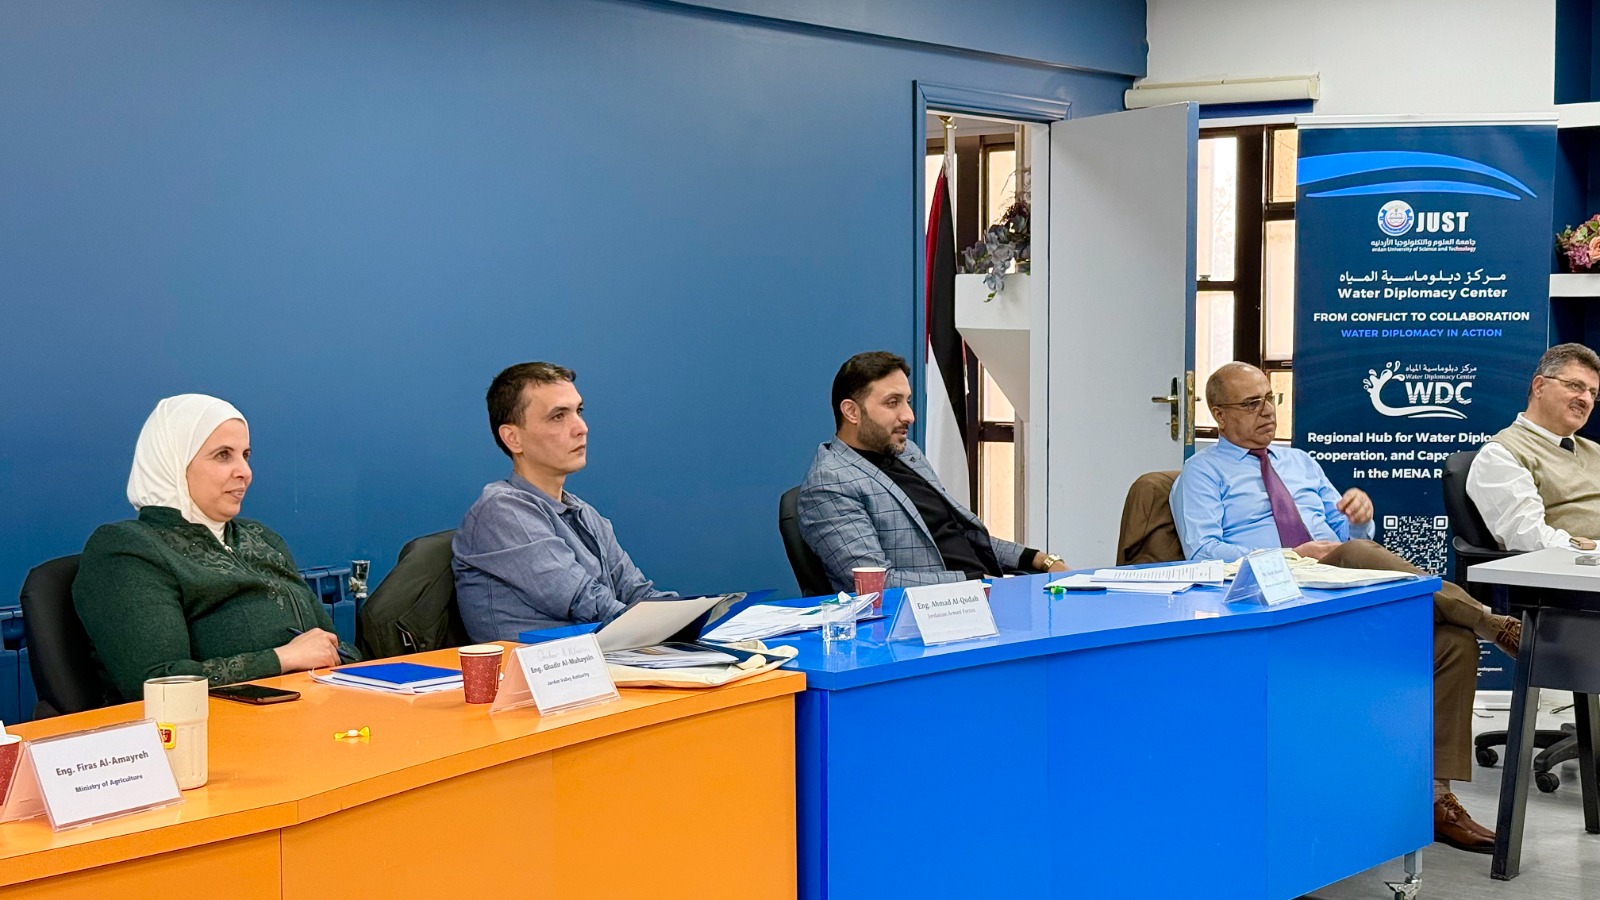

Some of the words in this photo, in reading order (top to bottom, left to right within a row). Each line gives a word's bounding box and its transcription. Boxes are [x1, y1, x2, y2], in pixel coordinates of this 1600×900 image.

[1416, 212, 1469, 232] JUST
[1338, 288, 1380, 298] Water
[1384, 287, 1457, 300] Diplomacy
[1460, 287, 1507, 298] Center
[1313, 312, 1348, 322] FROM
[1351, 312, 1408, 322] CONFLICT
[1411, 312, 1427, 321] TO
[1429, 312, 1530, 321] COLLABORATION
[1341, 329, 1378, 338] WATER
[1382, 329, 1444, 338] DIPLOMACY
[1447, 329, 1458, 337] IN
[1461, 329, 1502, 337] ACTION
[1460, 363, 1477, 373] مركز
[1405, 382, 1472, 405] WDC
[1308, 432, 1363, 445] Regional
[1366, 432, 1392, 443] Hub
[1395, 432, 1413, 443] for
[1415, 432, 1456, 443] Water
[1458, 432, 1492, 445] Diplo
[1308, 450, 1387, 462] Cooperation,
[1390, 450, 1414, 461] and
[1353, 468, 1364, 479] in
[1366, 468, 1389, 479] the
[1392, 468, 1431, 479] MENA
[1434, 468, 1443, 479] R
[917, 602, 930, 610] Eng.
[931, 599, 952, 608] Ahmad
[960, 595, 979, 605] Qudah
[530, 666, 543, 674] Eng.
[543, 661, 561, 671] Ghadir
[56, 767, 76, 777] Eng.
[76, 763, 98, 772] Firas
[99, 750, 149, 768] Al-Amayreh
[75, 783, 101, 793] Ministry
[101, 780, 109, 788] of
[110, 774, 143, 786] Agriculture
